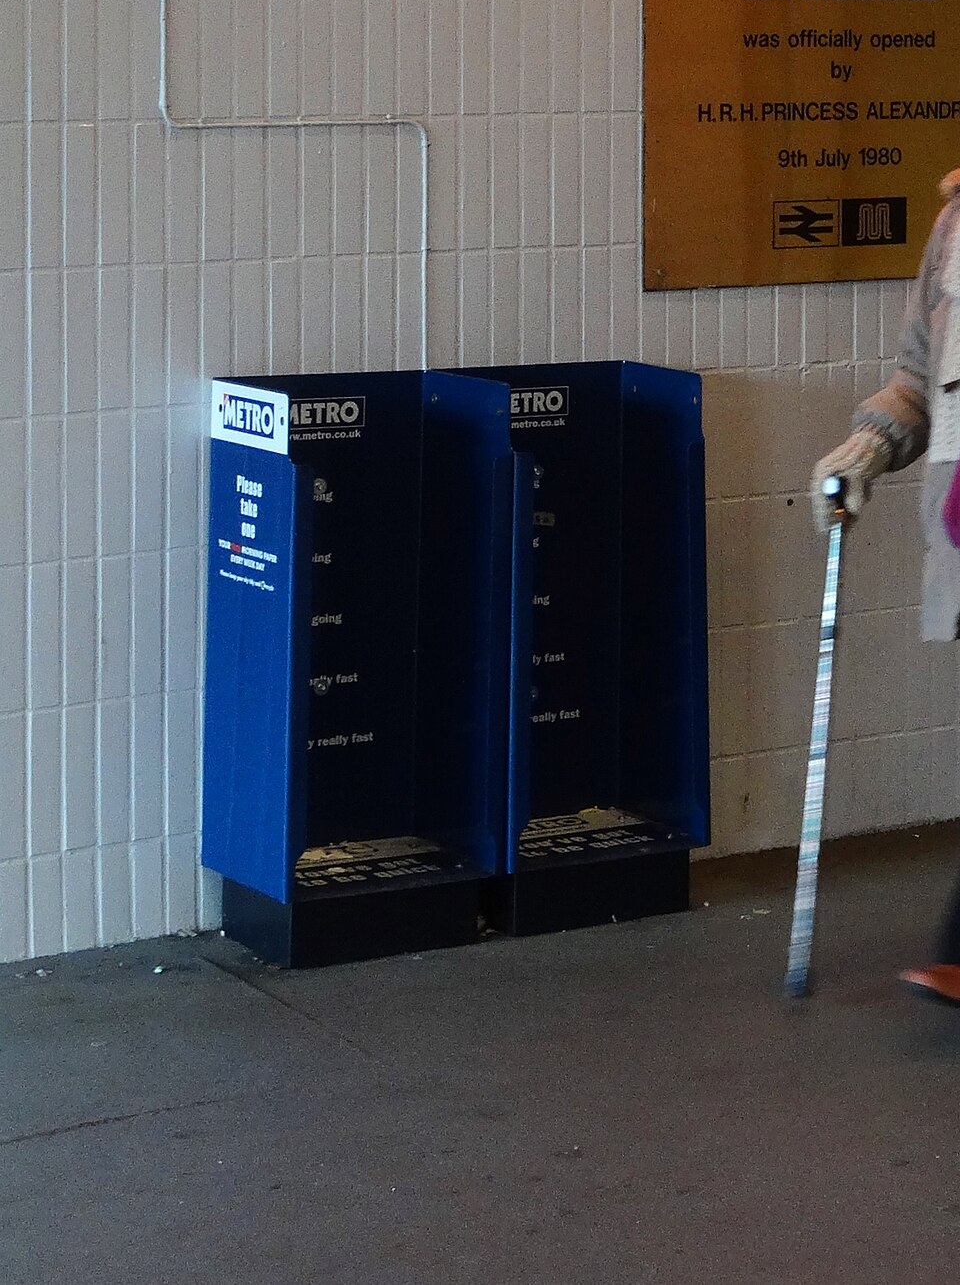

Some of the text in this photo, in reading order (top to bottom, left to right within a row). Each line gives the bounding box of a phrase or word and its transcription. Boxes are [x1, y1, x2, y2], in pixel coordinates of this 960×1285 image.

[742, 29, 936, 52] was officially opened
[829, 60, 853, 83] by
[761, 101, 859, 122] PRINCESS
[777, 146, 903, 171] 9th July 1980
[510, 390, 564, 414] ETRO
[223, 396, 275, 436] METRO
[236, 474, 263, 498] Please
[240, 498, 258, 518] take
[241, 522, 256, 539] one
[311, 552, 332, 565] ing
[533, 594, 550, 606] ing
[310, 613, 343, 627] going
[544, 652, 565, 663] fast
[335, 672, 359, 684] fast
[530, 708, 580, 723] eally fast
[317, 734, 349, 747] really
[351, 731, 374, 743] fast
